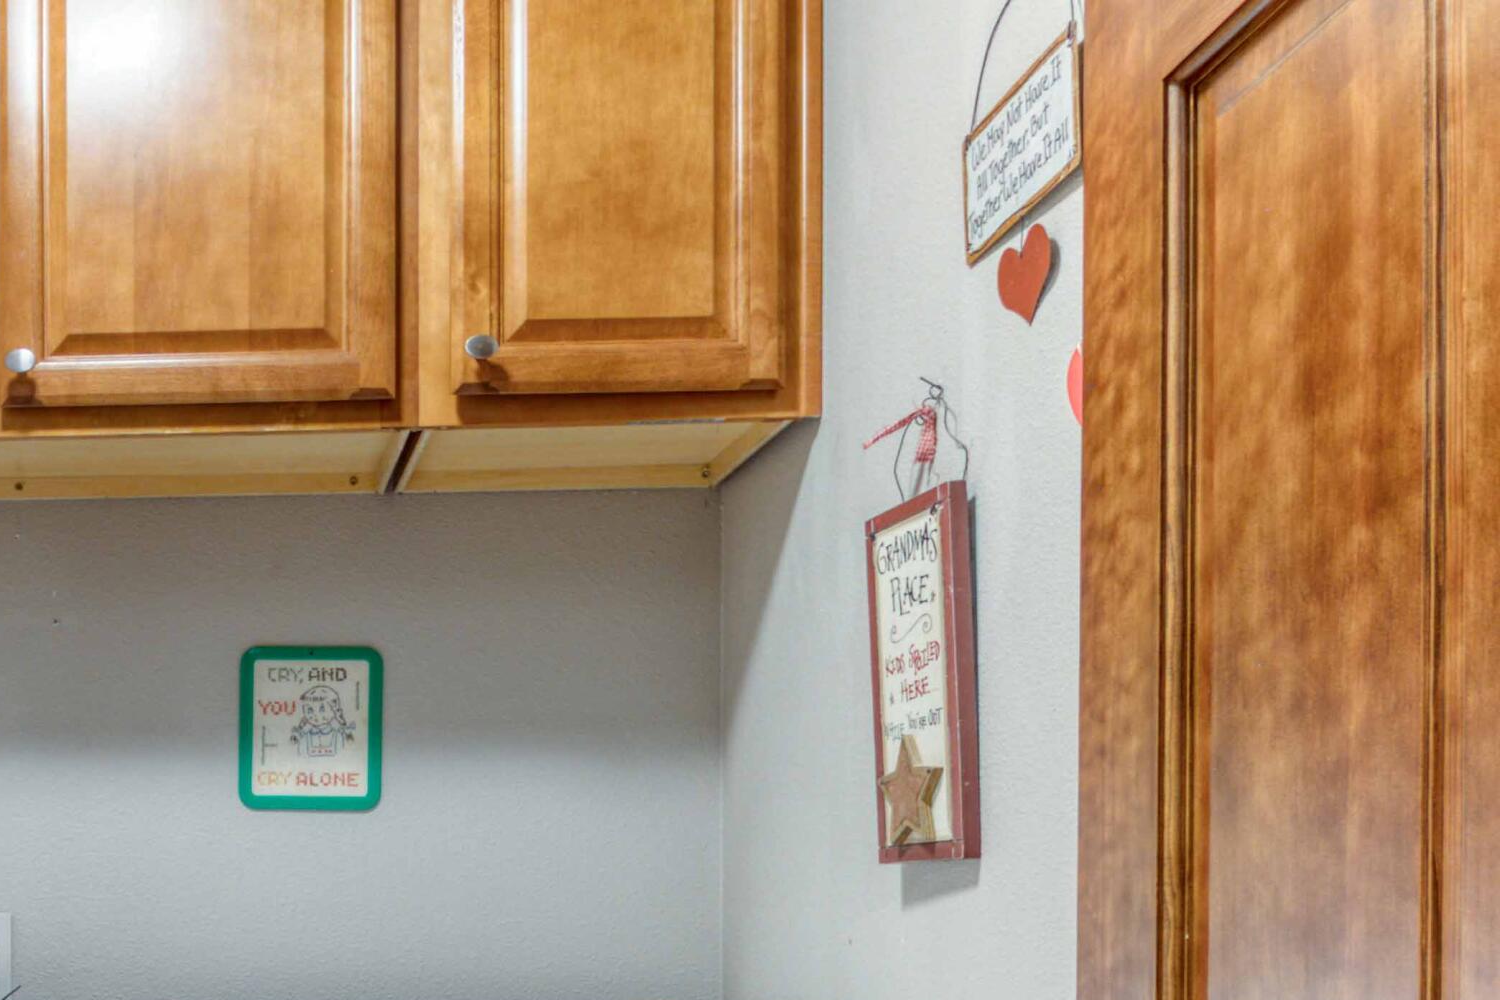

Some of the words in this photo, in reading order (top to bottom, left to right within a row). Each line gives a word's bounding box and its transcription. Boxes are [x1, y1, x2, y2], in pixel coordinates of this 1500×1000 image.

[971, 139, 988, 172] We
[986, 121, 1005, 153] May
[1006, 96, 1024, 134] Not
[1025, 75, 1049, 113] Have
[977, 169, 988, 200] All
[1030, 102, 1050, 137] But
[969, 190, 1003, 238] Together
[1002, 173, 1019, 202] We
[1019, 152, 1043, 188] Have
[1054, 117, 1069, 154] All
[876, 517, 938, 575] GRANDMA'S
[308, 668, 348, 682] AND
[900, 676, 931, 702] HERE
[258, 700, 297, 715] YOU
[257, 771, 293, 786] CRY
[296, 772, 361, 787] ALONE
